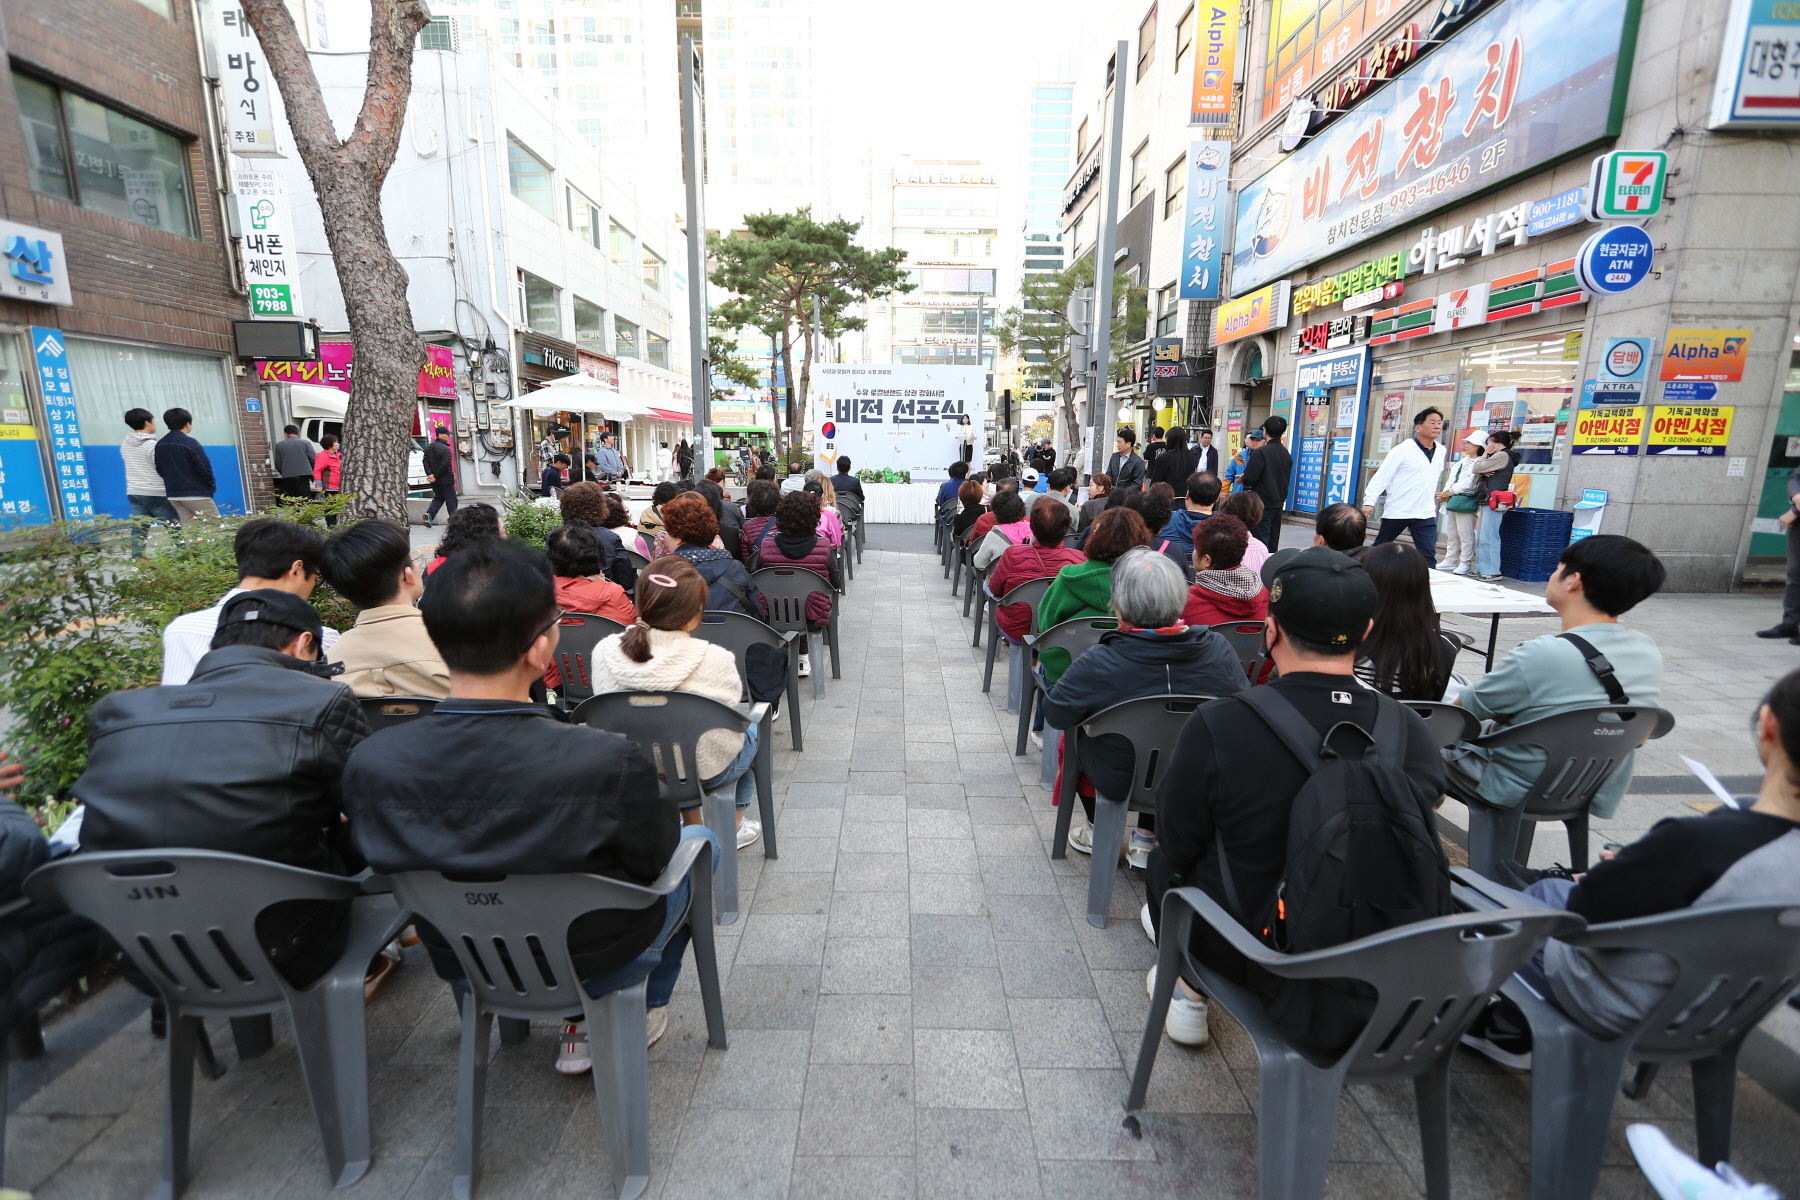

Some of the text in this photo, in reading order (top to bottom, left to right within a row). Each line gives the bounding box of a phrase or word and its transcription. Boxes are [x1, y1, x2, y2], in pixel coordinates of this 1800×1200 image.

[1207, 6, 1227, 66] Alpha
[1321, 25, 1351, 65] 배송
[1279, 64, 1304, 106] 납품
[235, 131, 255, 143] 주점
[1389, 139, 1507, 213] 993-4646 2F
[1532, 190, 1579, 219] 900-1181
[1326, 202, 1384, 245] 참치전문점
[1532, 211, 1567, 232] 기독교서적
[247, 234, 283, 255] 내폰
[1410, 201, 1531, 275] 아멘서적
[1600, 243, 1648, 257] 현금지급기
[250, 259, 286, 277] 체인지
[1609, 260, 1633, 270] ATM
[256, 288, 284, 299] 903-
[257, 300, 287, 312] 7988
[1224, 312, 1249, 334] Alpha
[1302, 321, 1329, 354] 인쇄
[1155, 345, 1179, 361] 노래
[1613, 351, 1639, 364] 담배
[1667, 343, 1719, 361] Alpha
[42, 366, 67, 379] 빌딩
[1310, 362, 1333, 386] 미래
[1332, 358, 1358, 377] 부동산
[45, 381, 70, 393] 모텔
[45, 395, 75, 407] 토(땅)지
[50, 409, 76, 421] 상가
[835, 399, 964, 425] 비전 선포식
[1589, 408, 1634, 418] 기독교백화점
[1667, 407, 1719, 417] 기독교백화점
[53, 424, 78, 434] 점포
[1579, 417, 1642, 436] 아멘서점
[1654, 417, 1727, 436] 아멘서점
[56, 438, 81, 448] 주택
[1617, 446, 1629, 454] 지층
[1700, 446, 1714, 454] 지층
[57, 451, 84, 462] 아파트
[61, 465, 85, 476] 원룸
[1328, 441, 1351, 505] 부동산
[62, 479, 89, 489] 오피스텔
[66, 492, 91, 503] 월세
[69, 505, 93, 517] 전세
[127, 884, 180, 900] JIN
[464, 892, 504, 906] SOK
